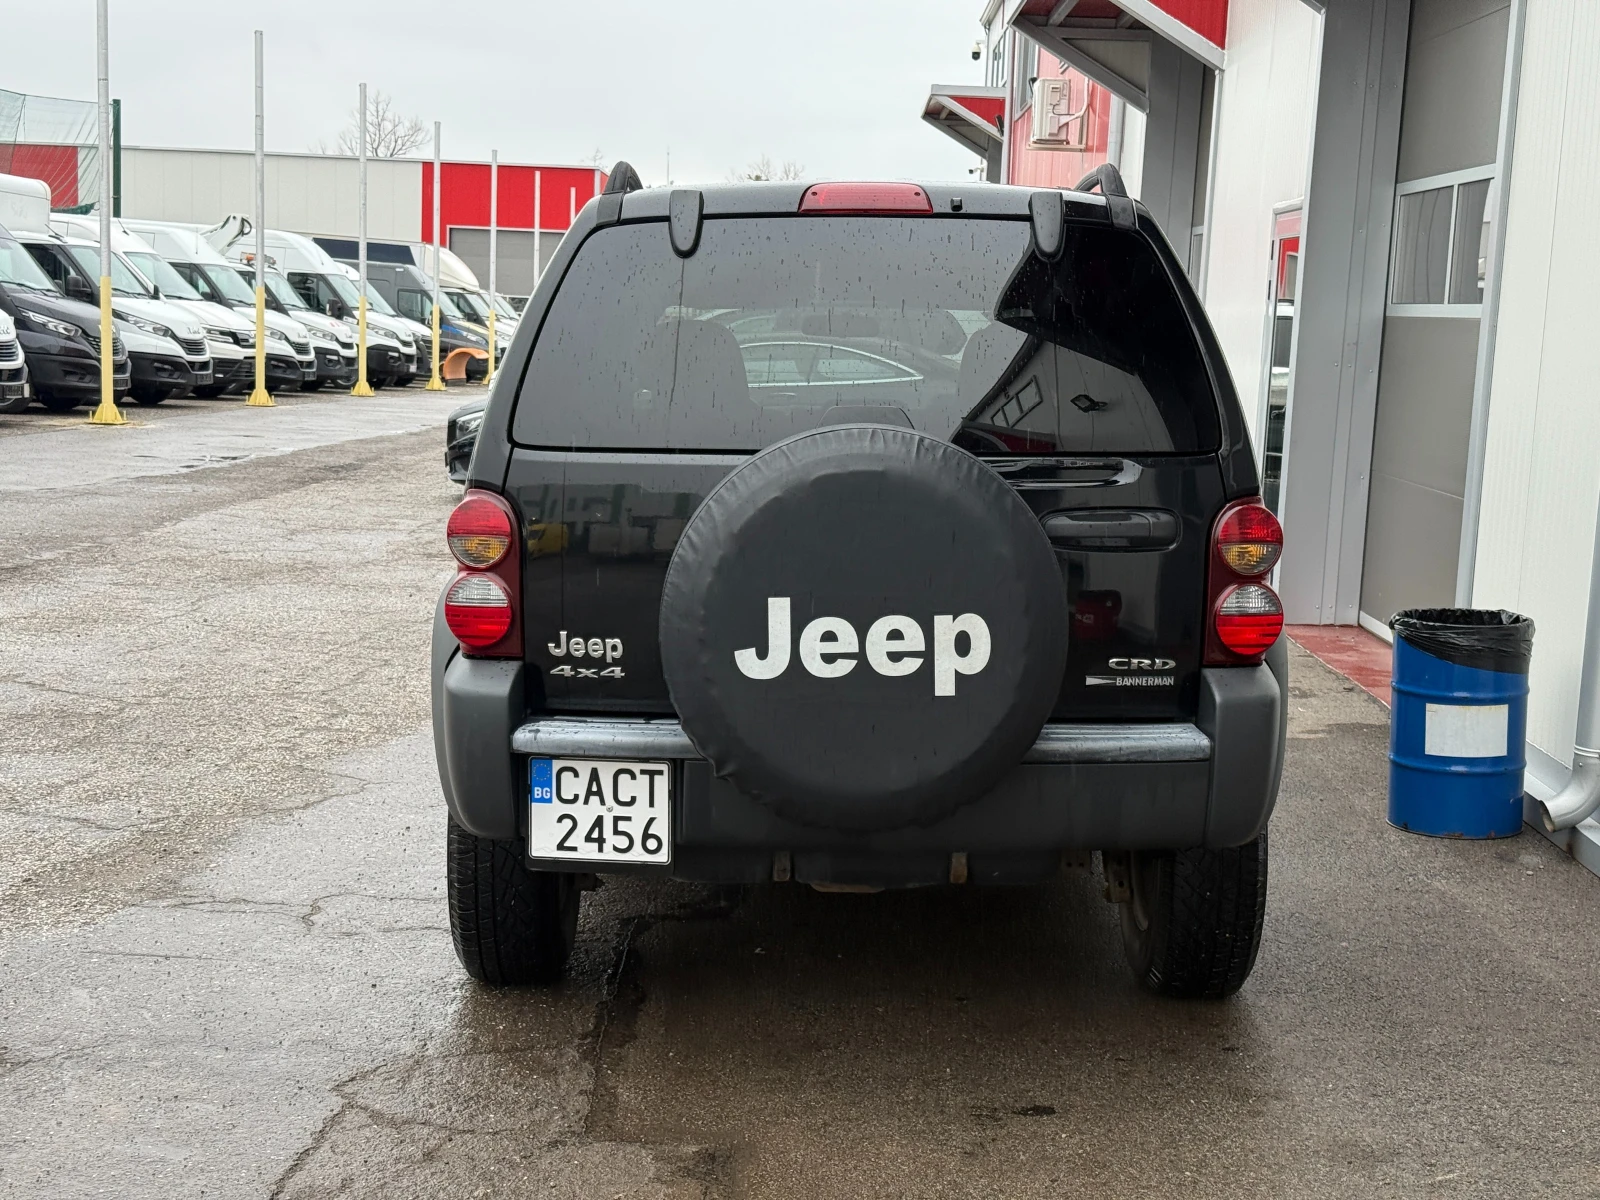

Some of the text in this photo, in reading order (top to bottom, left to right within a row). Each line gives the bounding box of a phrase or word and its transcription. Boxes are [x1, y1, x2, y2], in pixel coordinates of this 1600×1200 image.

[547, 630, 624, 663] Jeep
[734, 596, 992, 697] Jeep
[549, 665, 626, 679] 4x4
[1108, 657, 1177, 670] CRD
[1116, 676, 1175, 686] BANNERMAN
[534, 787, 551, 800] BG
[555, 766, 664, 808] CACT
[556, 813, 664, 856] 2456
